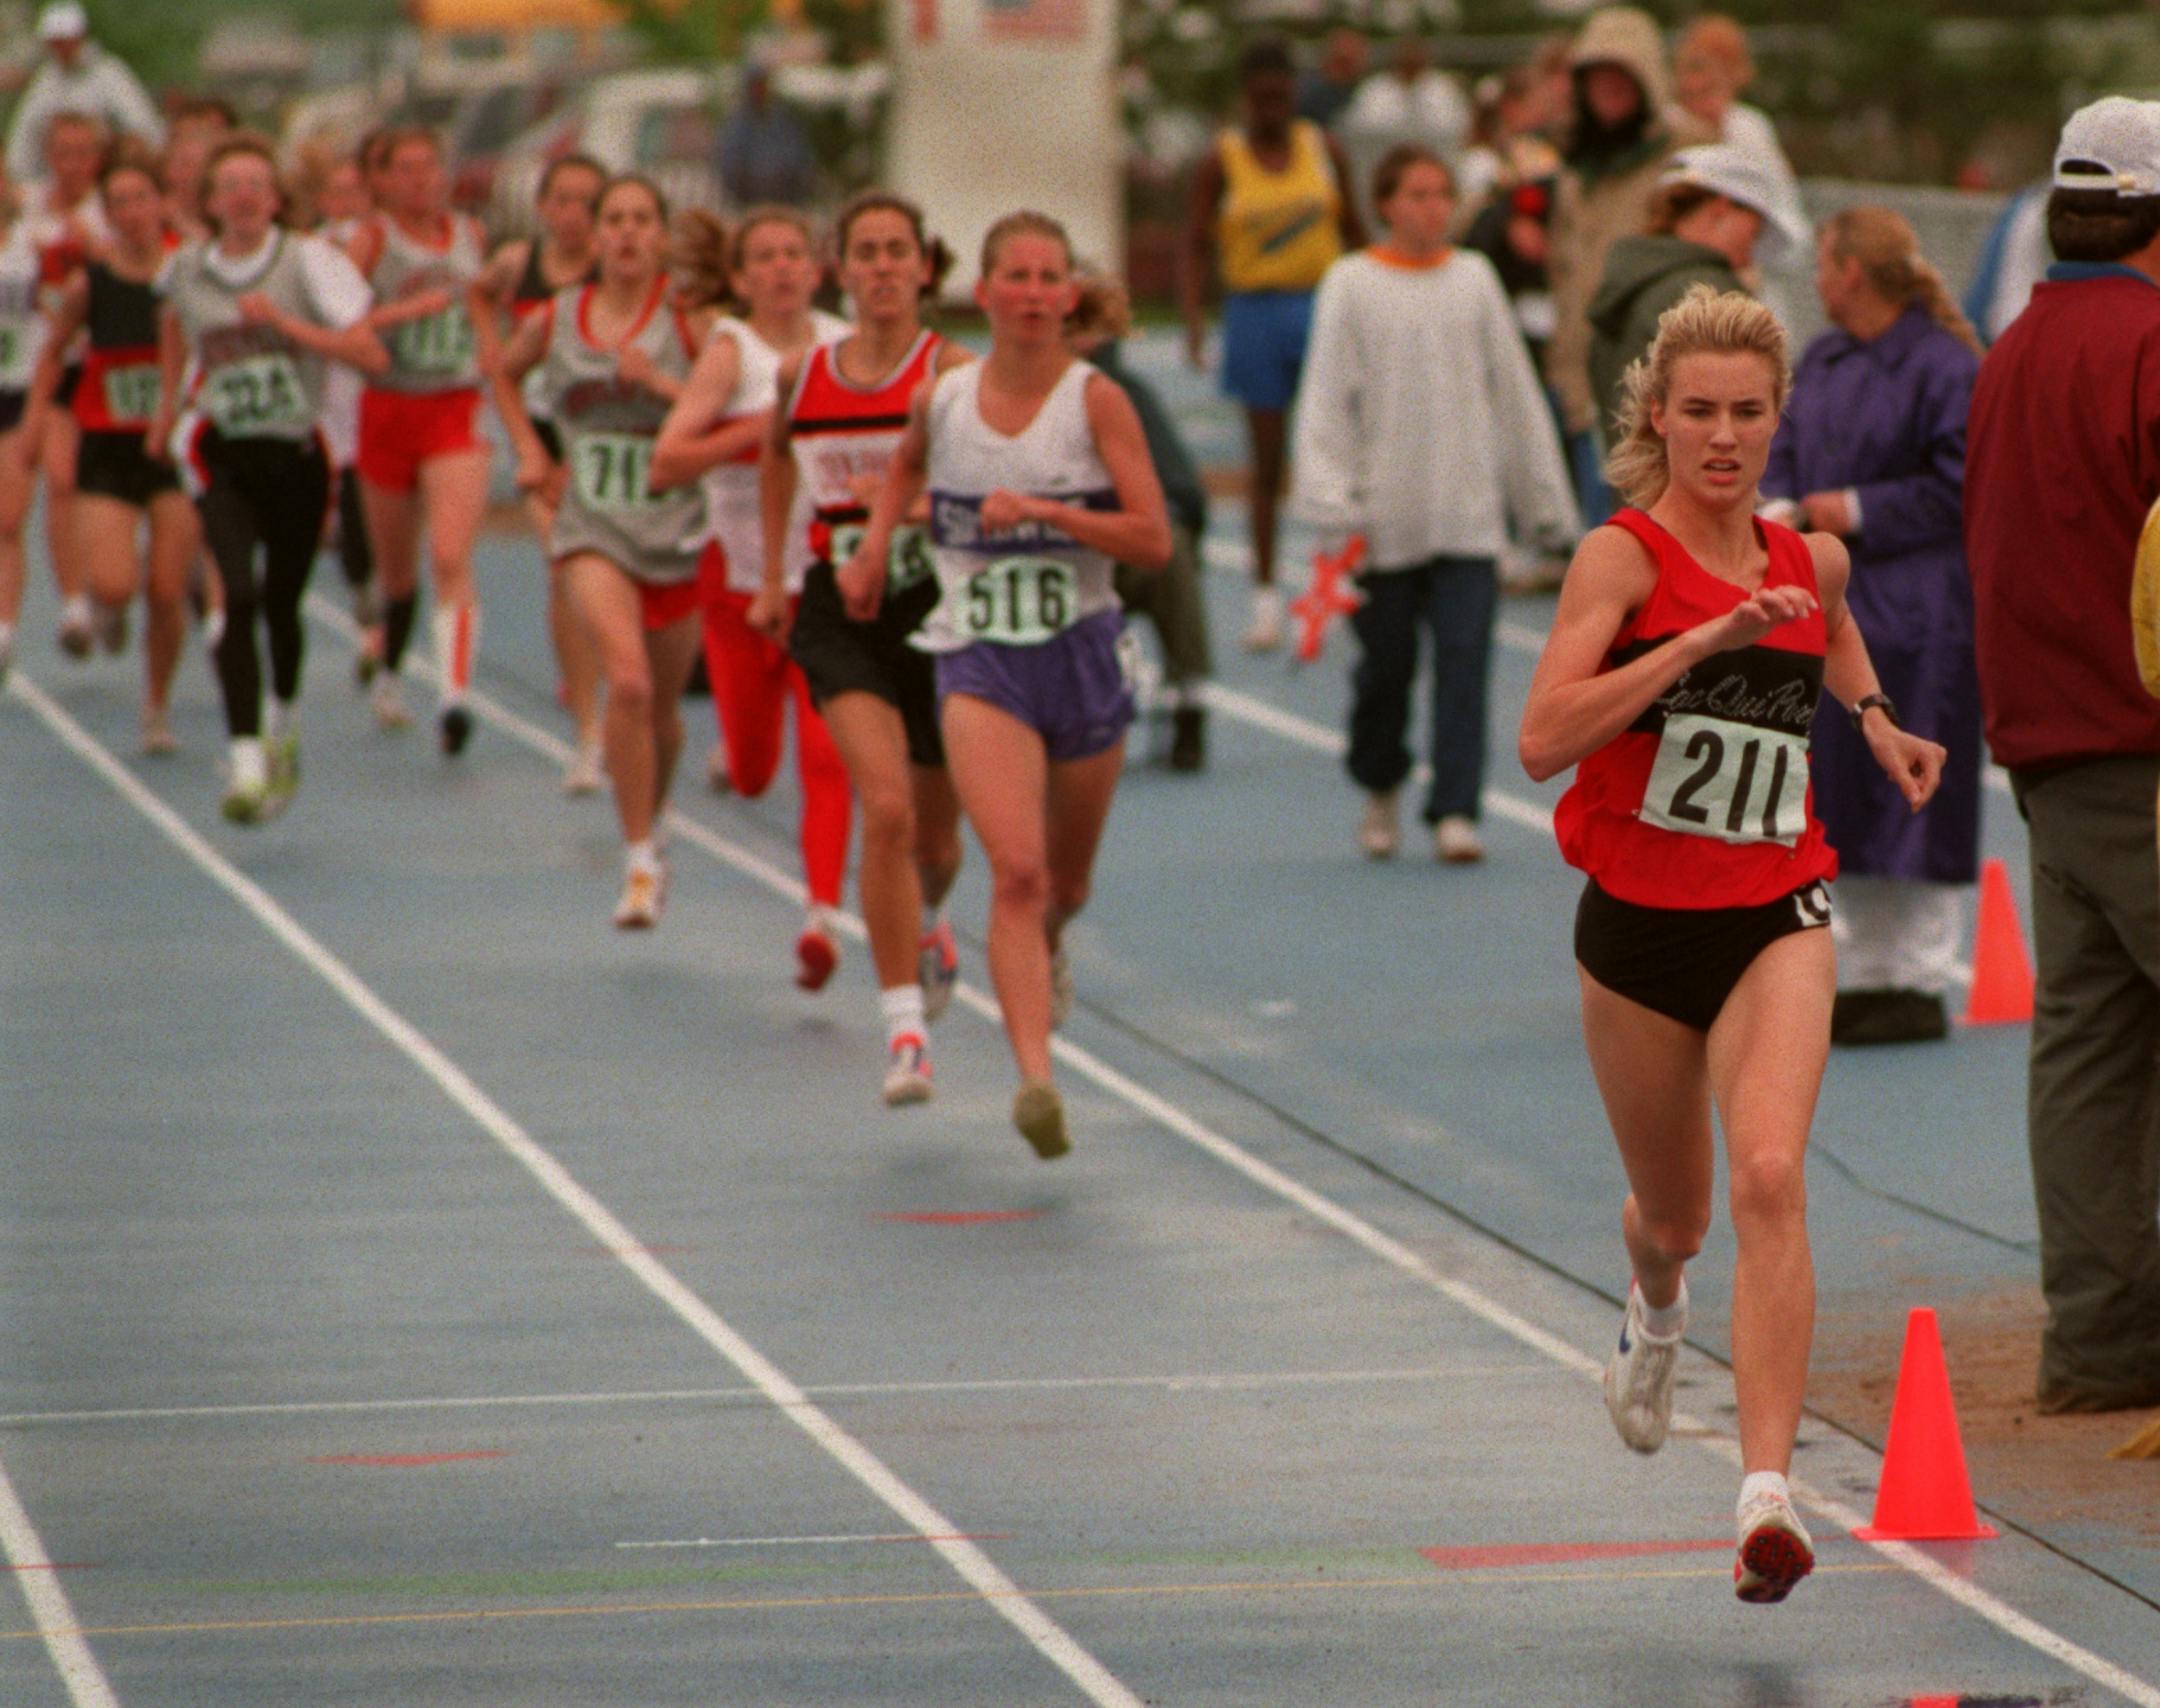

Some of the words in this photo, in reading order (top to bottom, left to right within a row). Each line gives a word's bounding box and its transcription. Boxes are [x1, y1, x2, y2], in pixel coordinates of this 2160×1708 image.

[590, 444, 637, 501] 71
[969, 567, 1066, 631] 516
[1668, 729, 1789, 838] 211
